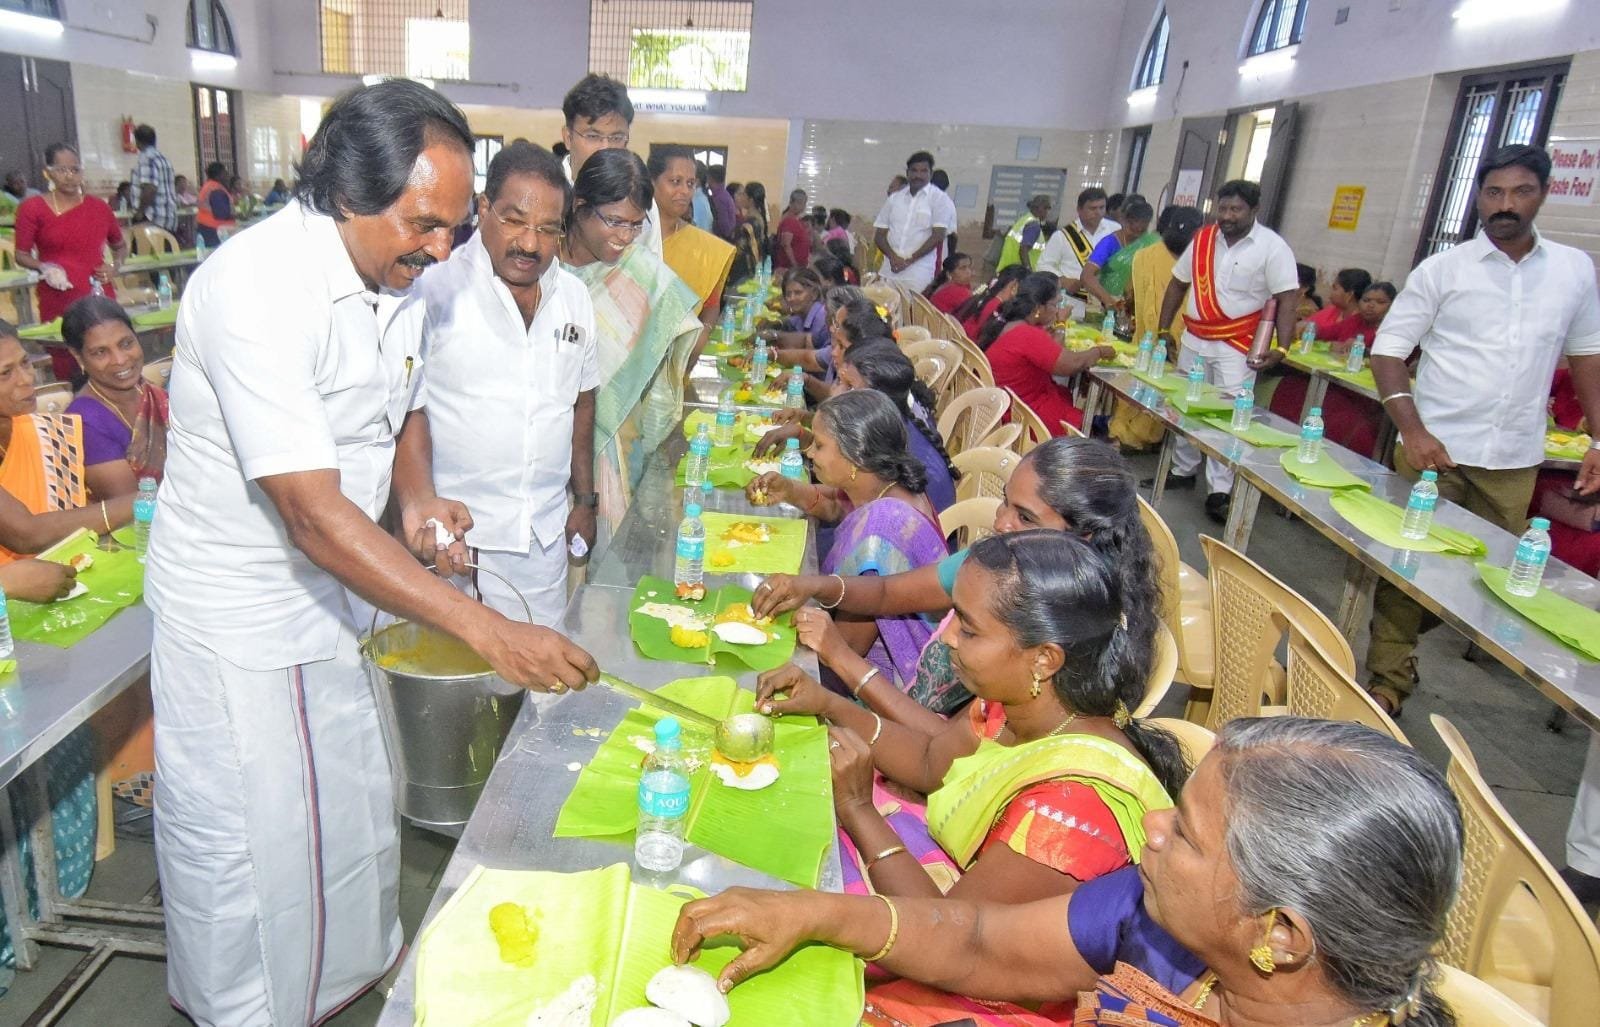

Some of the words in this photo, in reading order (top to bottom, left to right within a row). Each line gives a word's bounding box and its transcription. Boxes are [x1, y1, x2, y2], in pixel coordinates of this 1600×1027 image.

[645, 103, 666, 111] WHAT
[670, 104, 686, 112] YOU
[688, 105, 707, 113] TAKE
[1552, 148, 1578, 169] Please
[1569, 176, 1595, 197] Food
